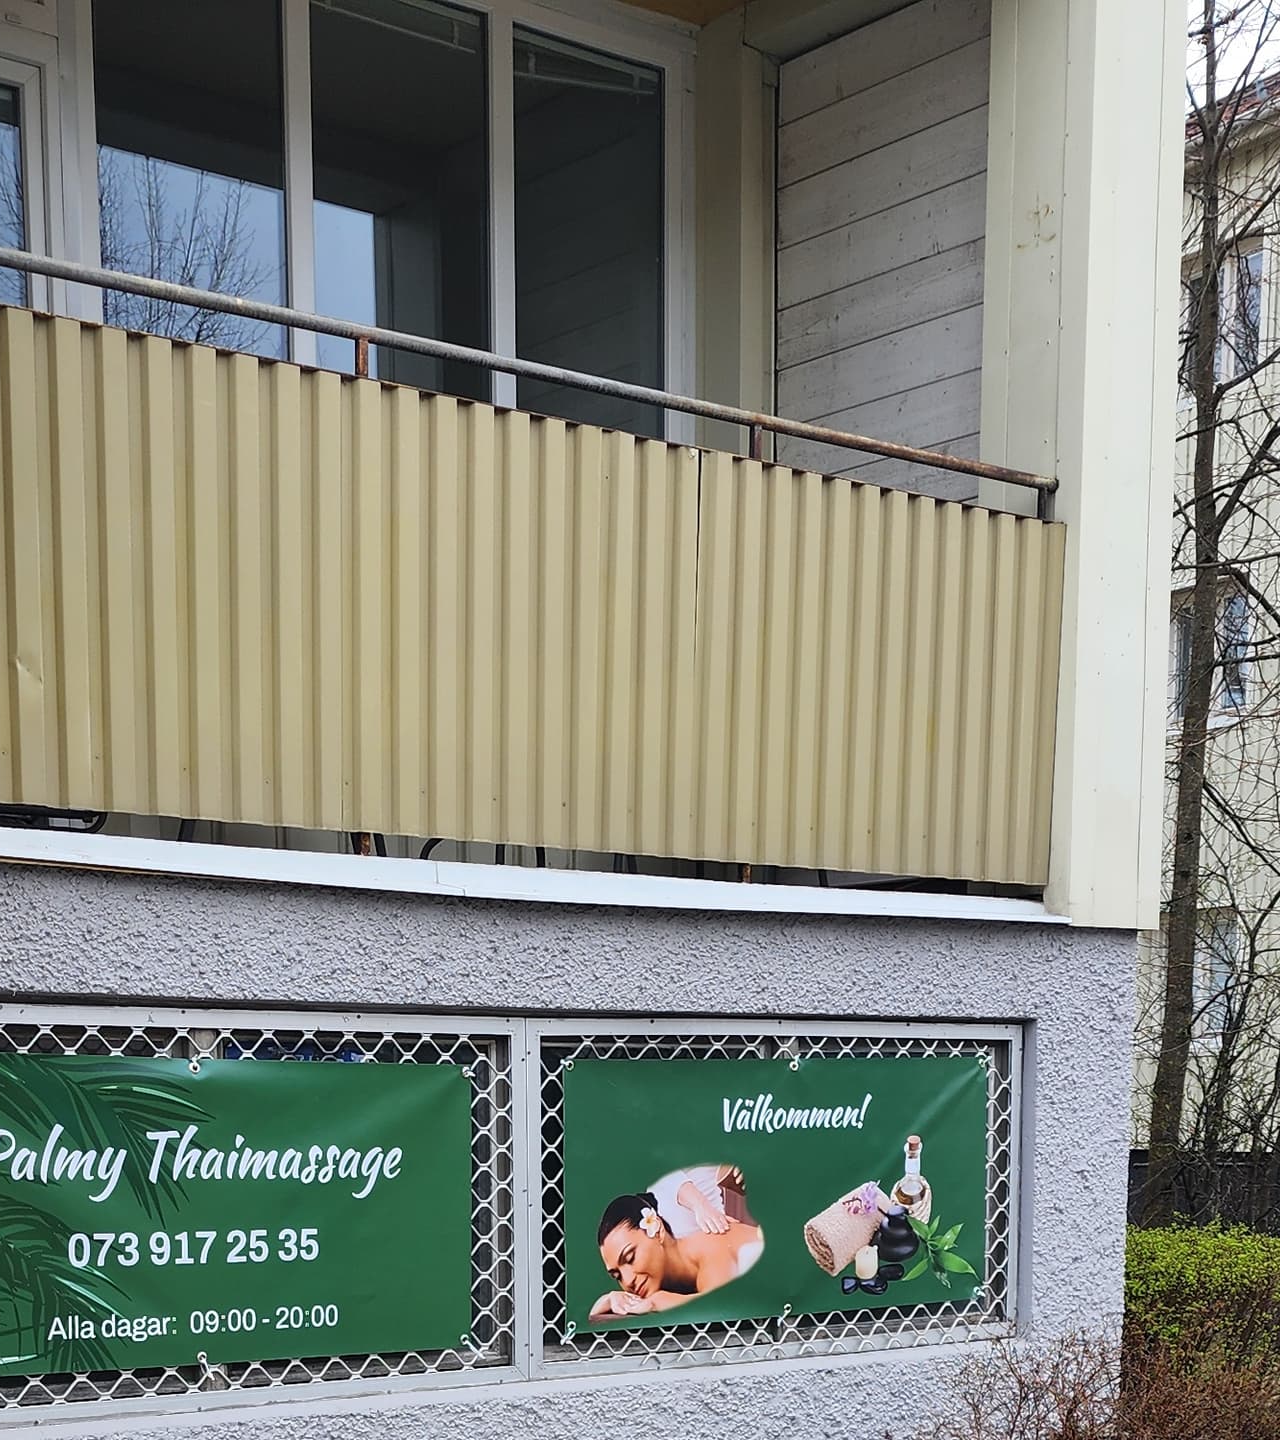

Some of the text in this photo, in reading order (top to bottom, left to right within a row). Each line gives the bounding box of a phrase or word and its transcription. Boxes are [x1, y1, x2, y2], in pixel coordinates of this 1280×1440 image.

[723, 1092, 873, 1134] Välkommen!
[145, 1124, 403, 1199] Thaimassage
[68, 1228, 319, 1268] 073 917 25 35
[47, 1314, 97, 1341] Alla
[101, 1311, 177, 1342] dagar:
[189, 1308, 257, 1334] 09:00
[275, 1304, 339, 1330] 20:00
